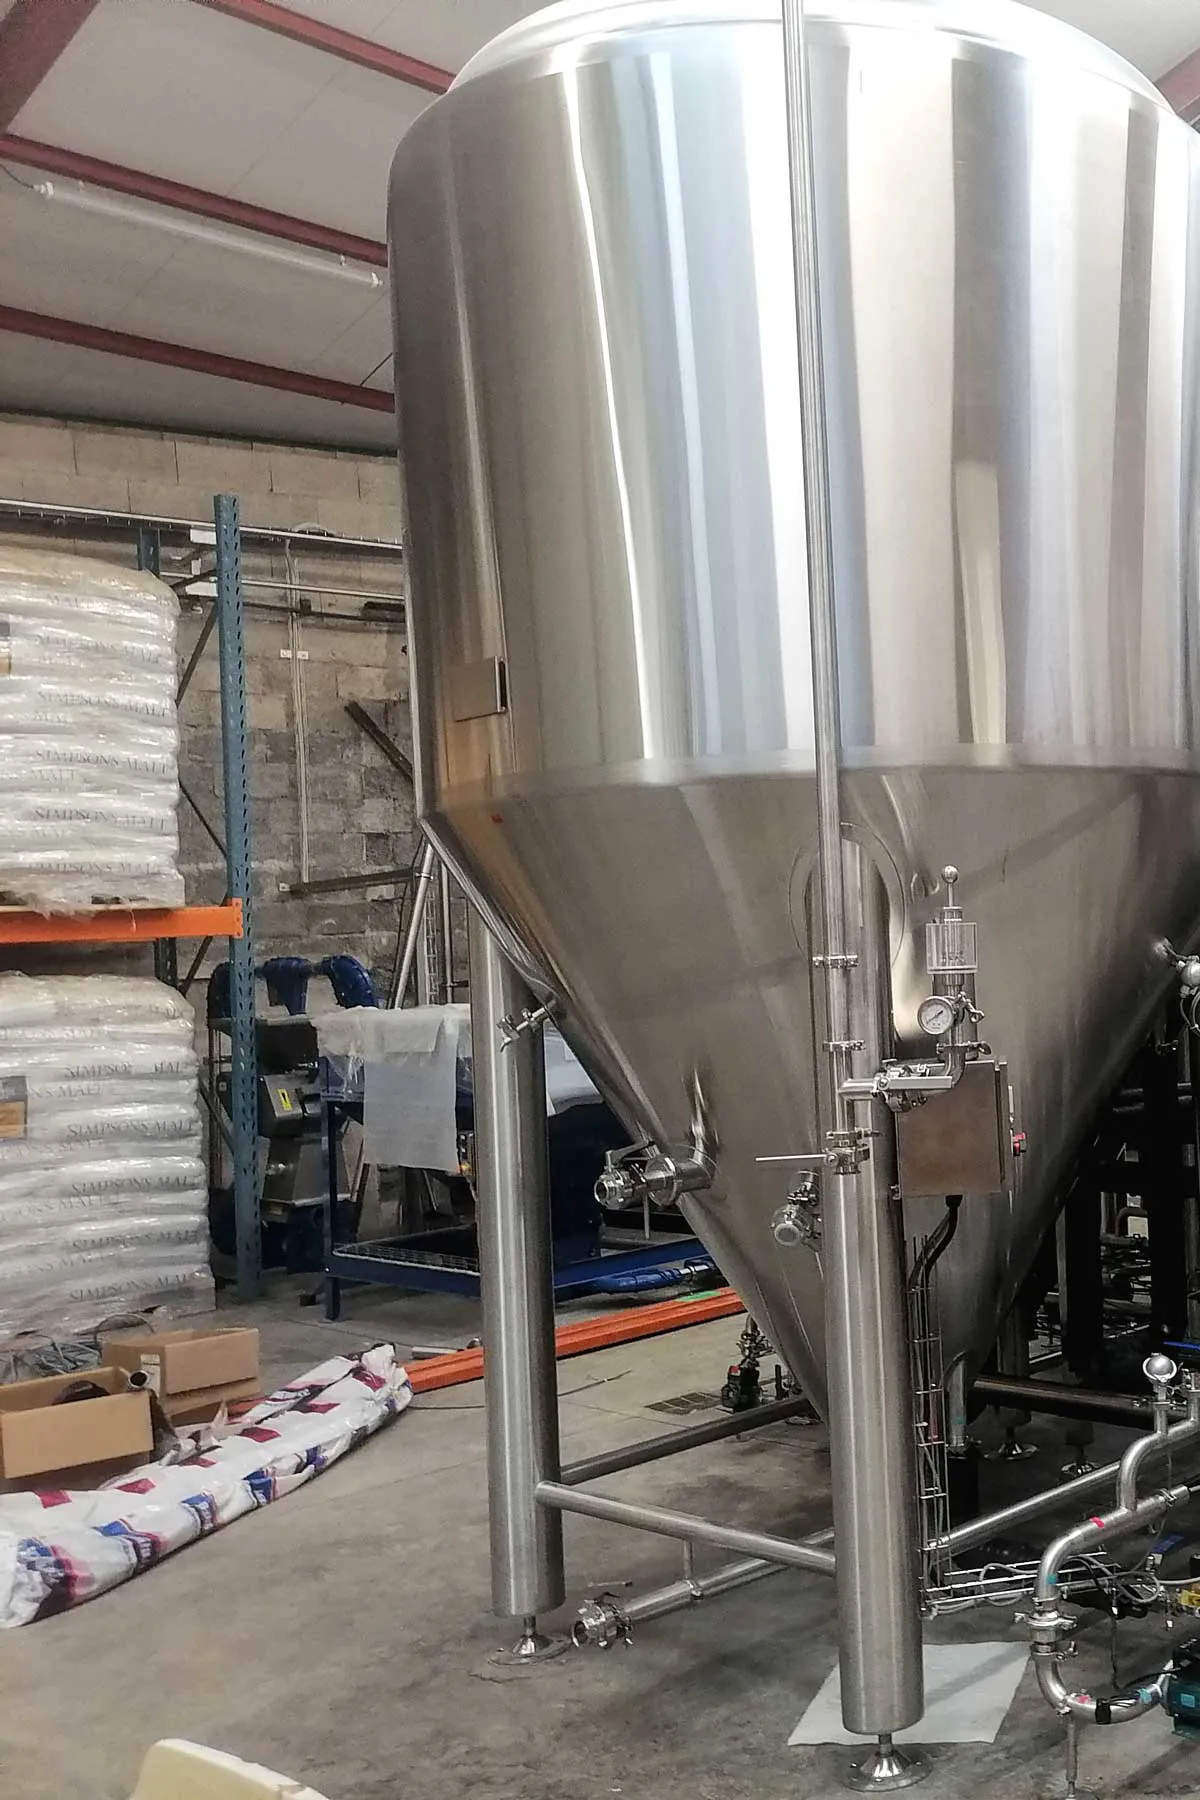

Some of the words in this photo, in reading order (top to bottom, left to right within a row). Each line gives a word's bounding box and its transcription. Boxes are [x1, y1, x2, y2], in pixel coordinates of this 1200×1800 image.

[38, 691, 119, 708] SIMPSONS
[36, 751, 119, 766] SIMPSONS
[126, 757, 168, 775] MALT
[34, 806, 118, 824] SIMPSONS
[67, 1121, 148, 1136] SIMPSONS
[154, 1118, 195, 1135] MALT
[72, 1179, 151, 1195] SIMPSONS
